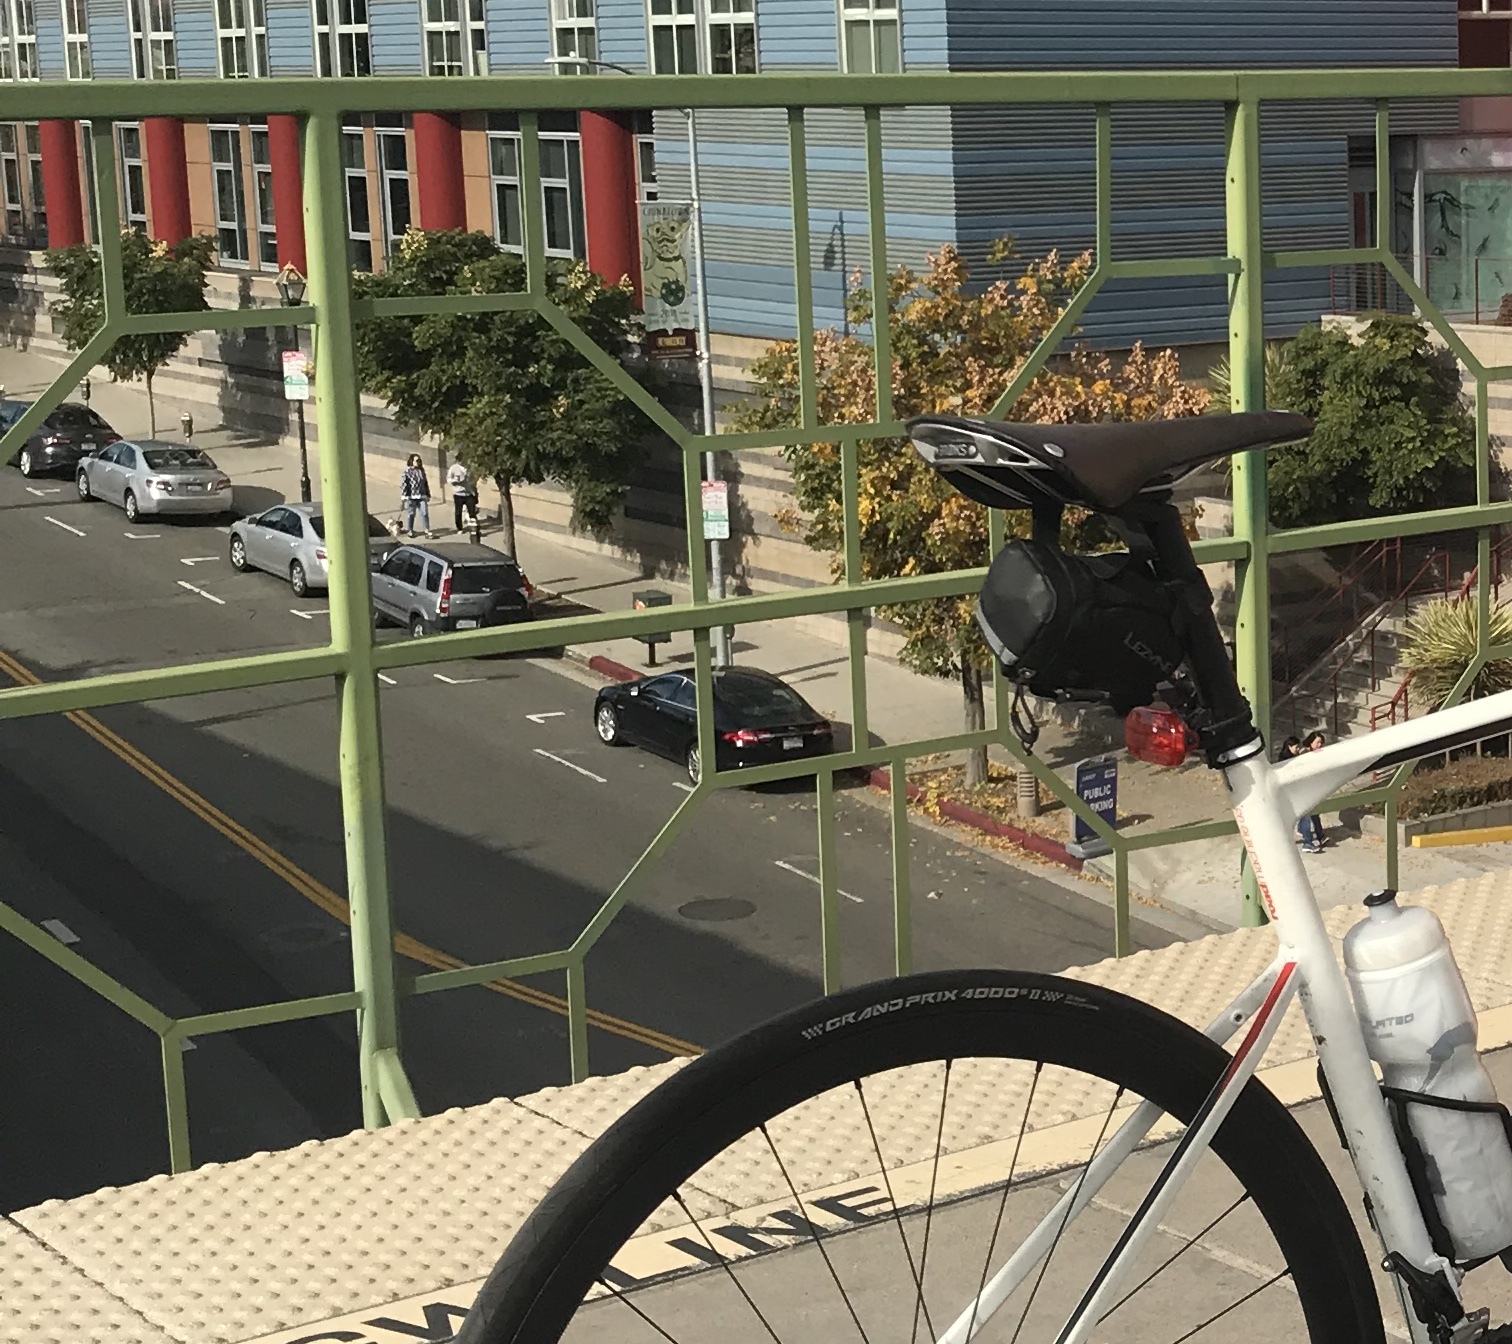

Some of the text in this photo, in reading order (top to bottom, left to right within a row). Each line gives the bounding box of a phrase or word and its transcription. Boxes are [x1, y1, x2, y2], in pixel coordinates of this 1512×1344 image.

[1083, 784, 1112, 801] PUBLIC
[825, 998, 904, 1033] GRAND
[904, 989, 958, 1008] PRIX
